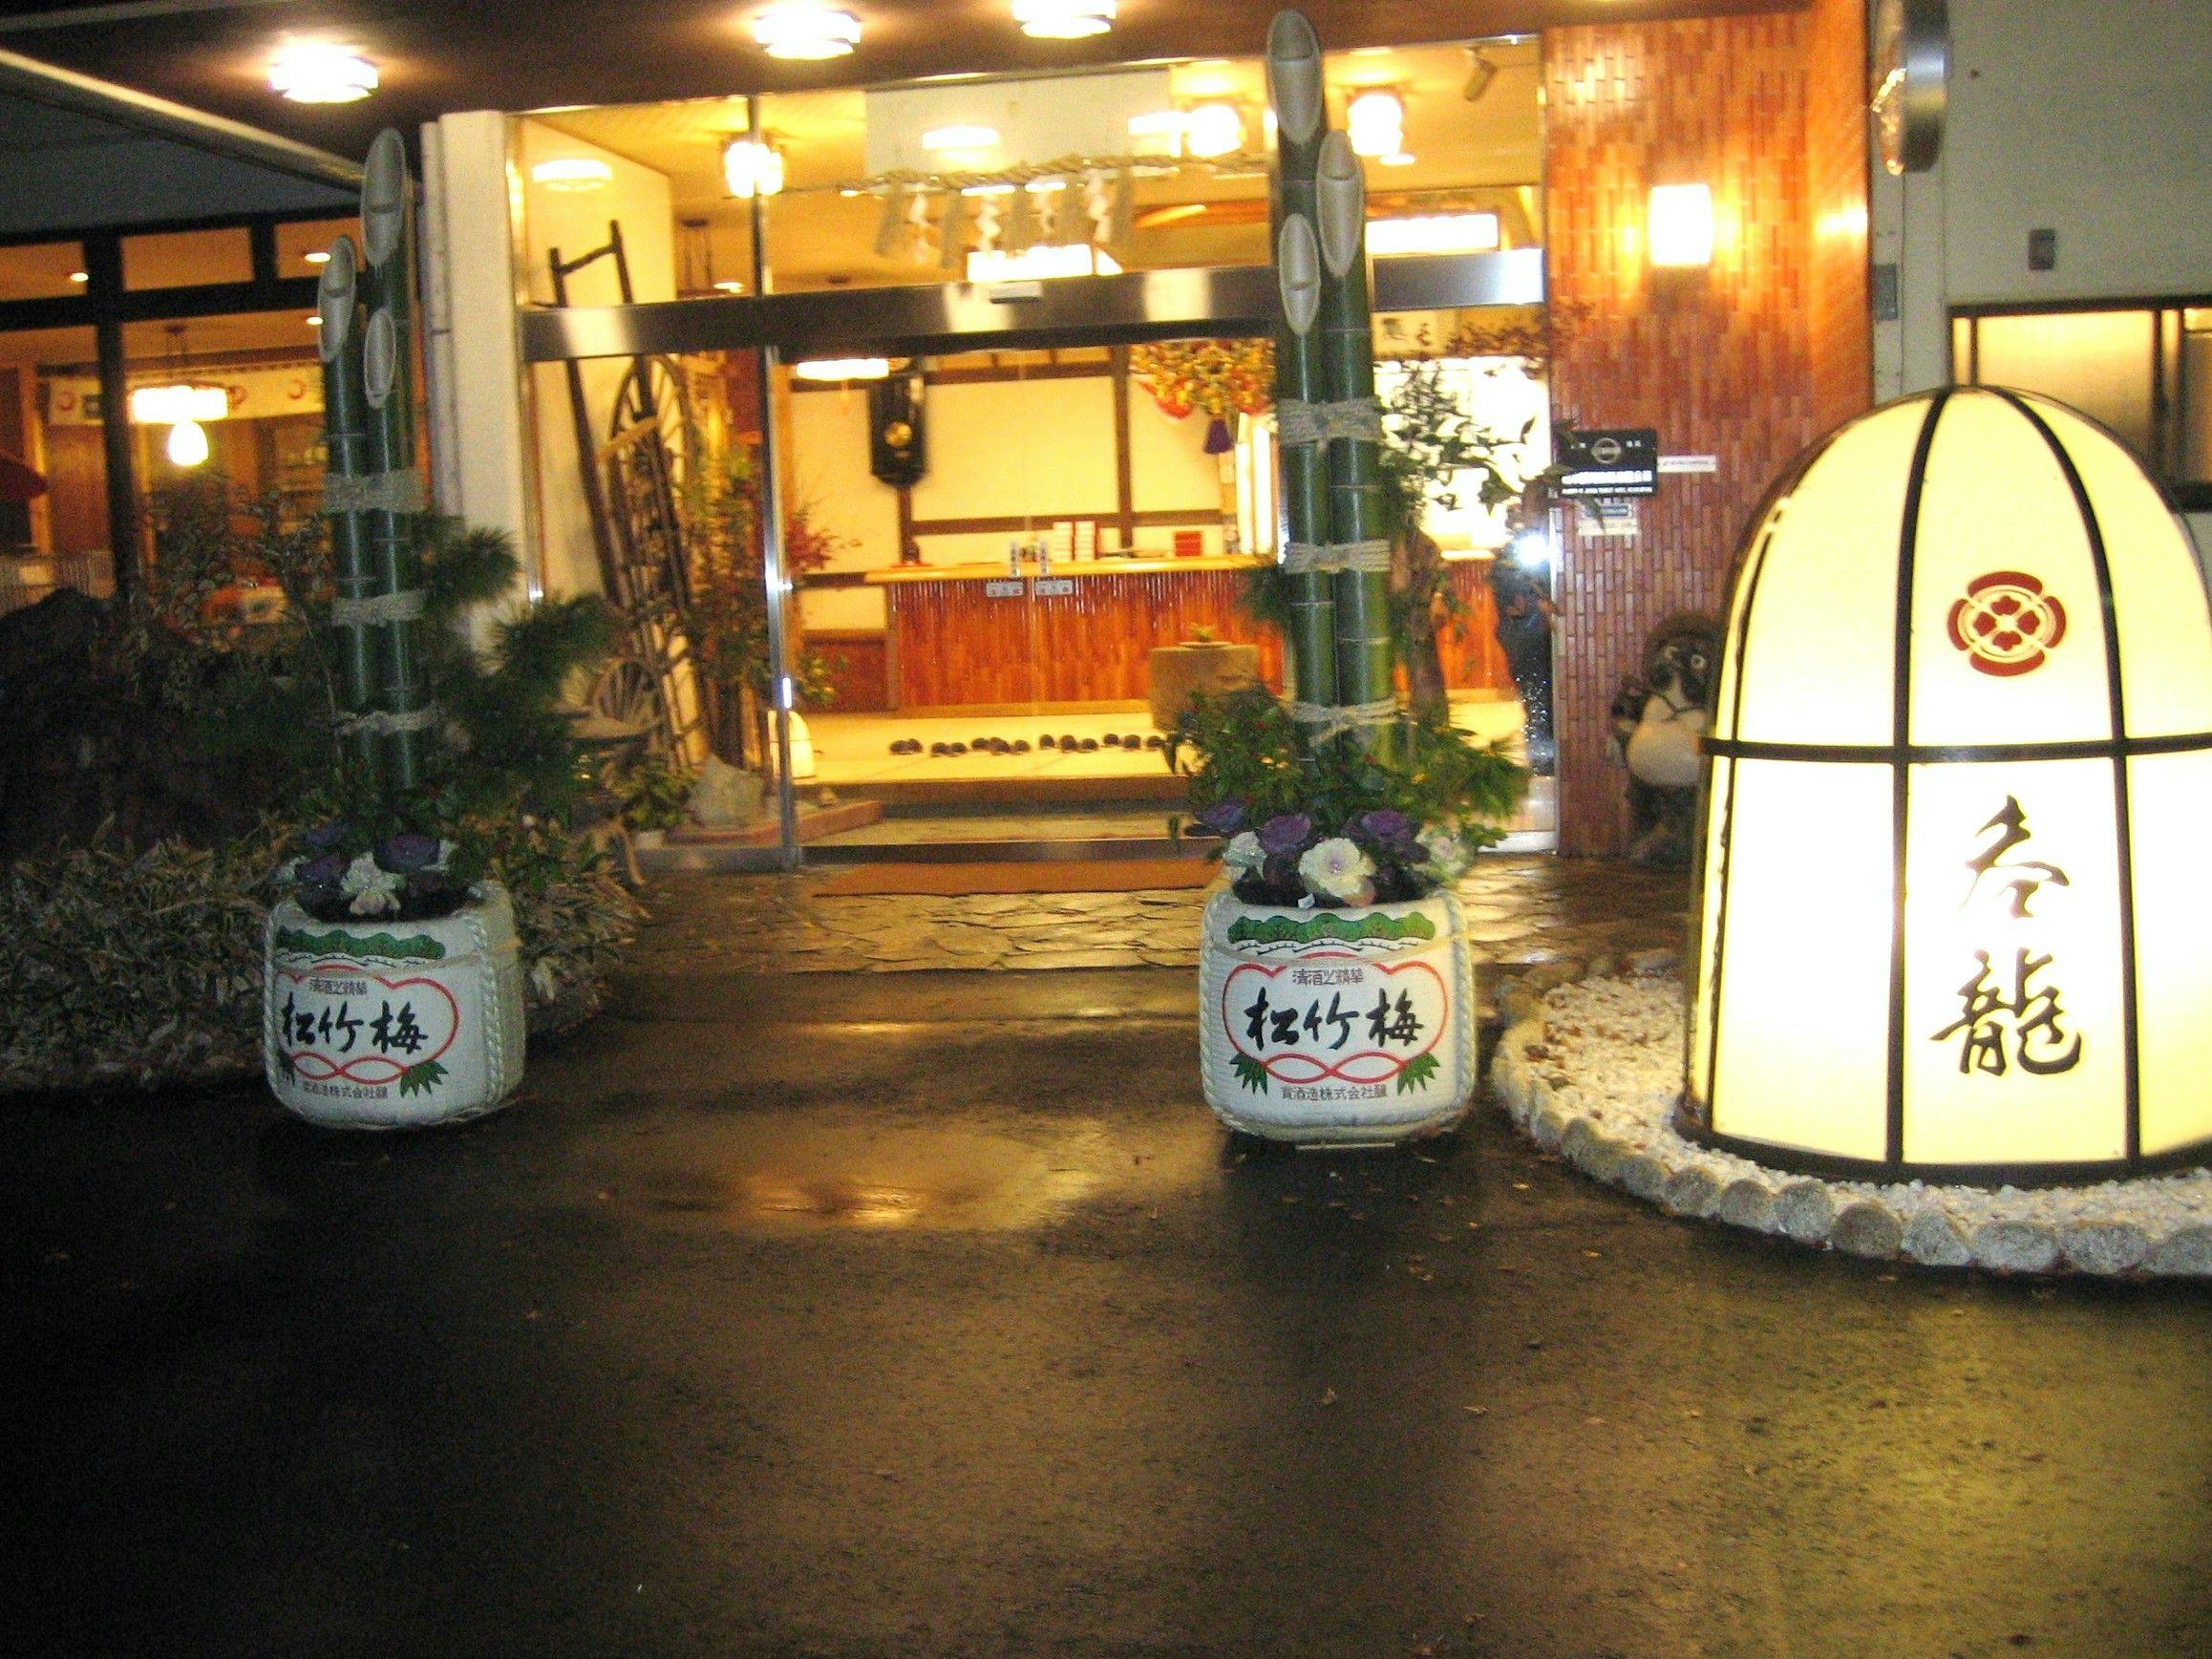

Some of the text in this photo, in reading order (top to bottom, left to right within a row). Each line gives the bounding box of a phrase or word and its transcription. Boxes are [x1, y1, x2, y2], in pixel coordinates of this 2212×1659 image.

[282, 991, 429, 1053] 松竹梅
[1244, 987, 1424, 1051] 松竹梅
